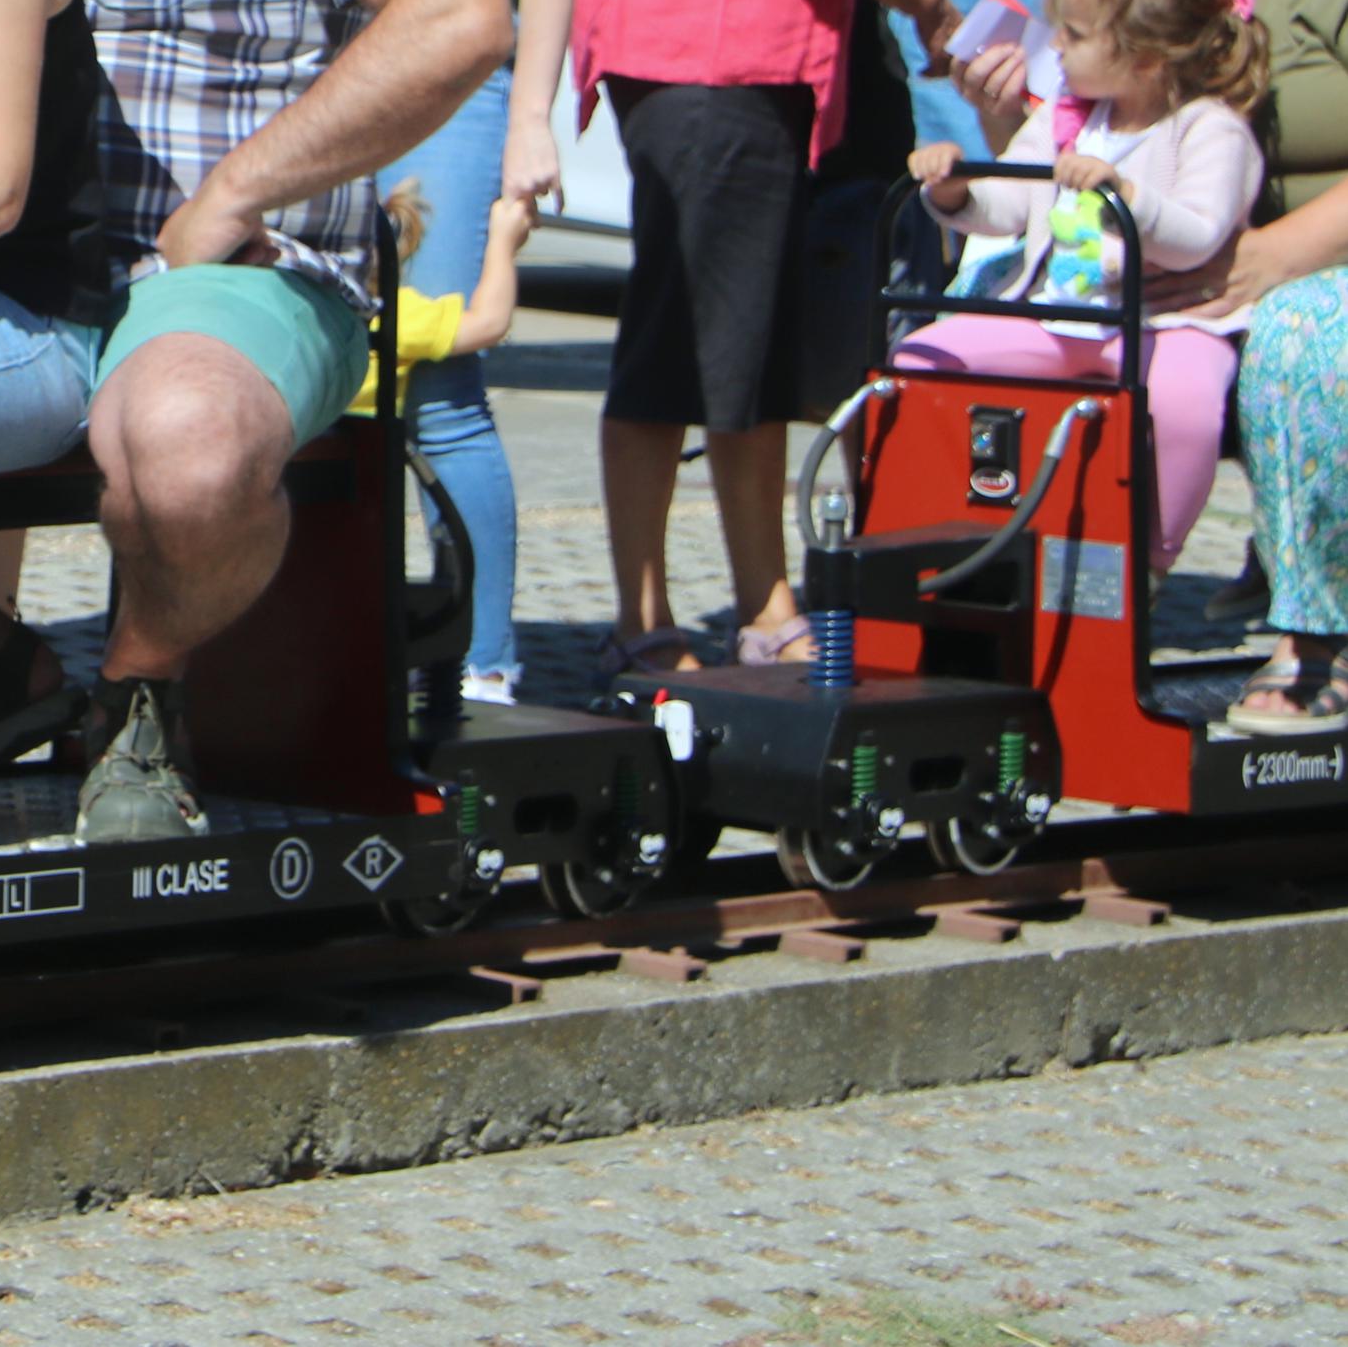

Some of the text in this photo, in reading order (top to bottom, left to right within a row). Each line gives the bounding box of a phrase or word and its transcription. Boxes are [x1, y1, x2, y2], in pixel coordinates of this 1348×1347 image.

[156, 858, 230, 897] CLASE
[281, 848, 303, 888] D
[365, 847, 383, 876] R
[10, 883, 22, 908] L
